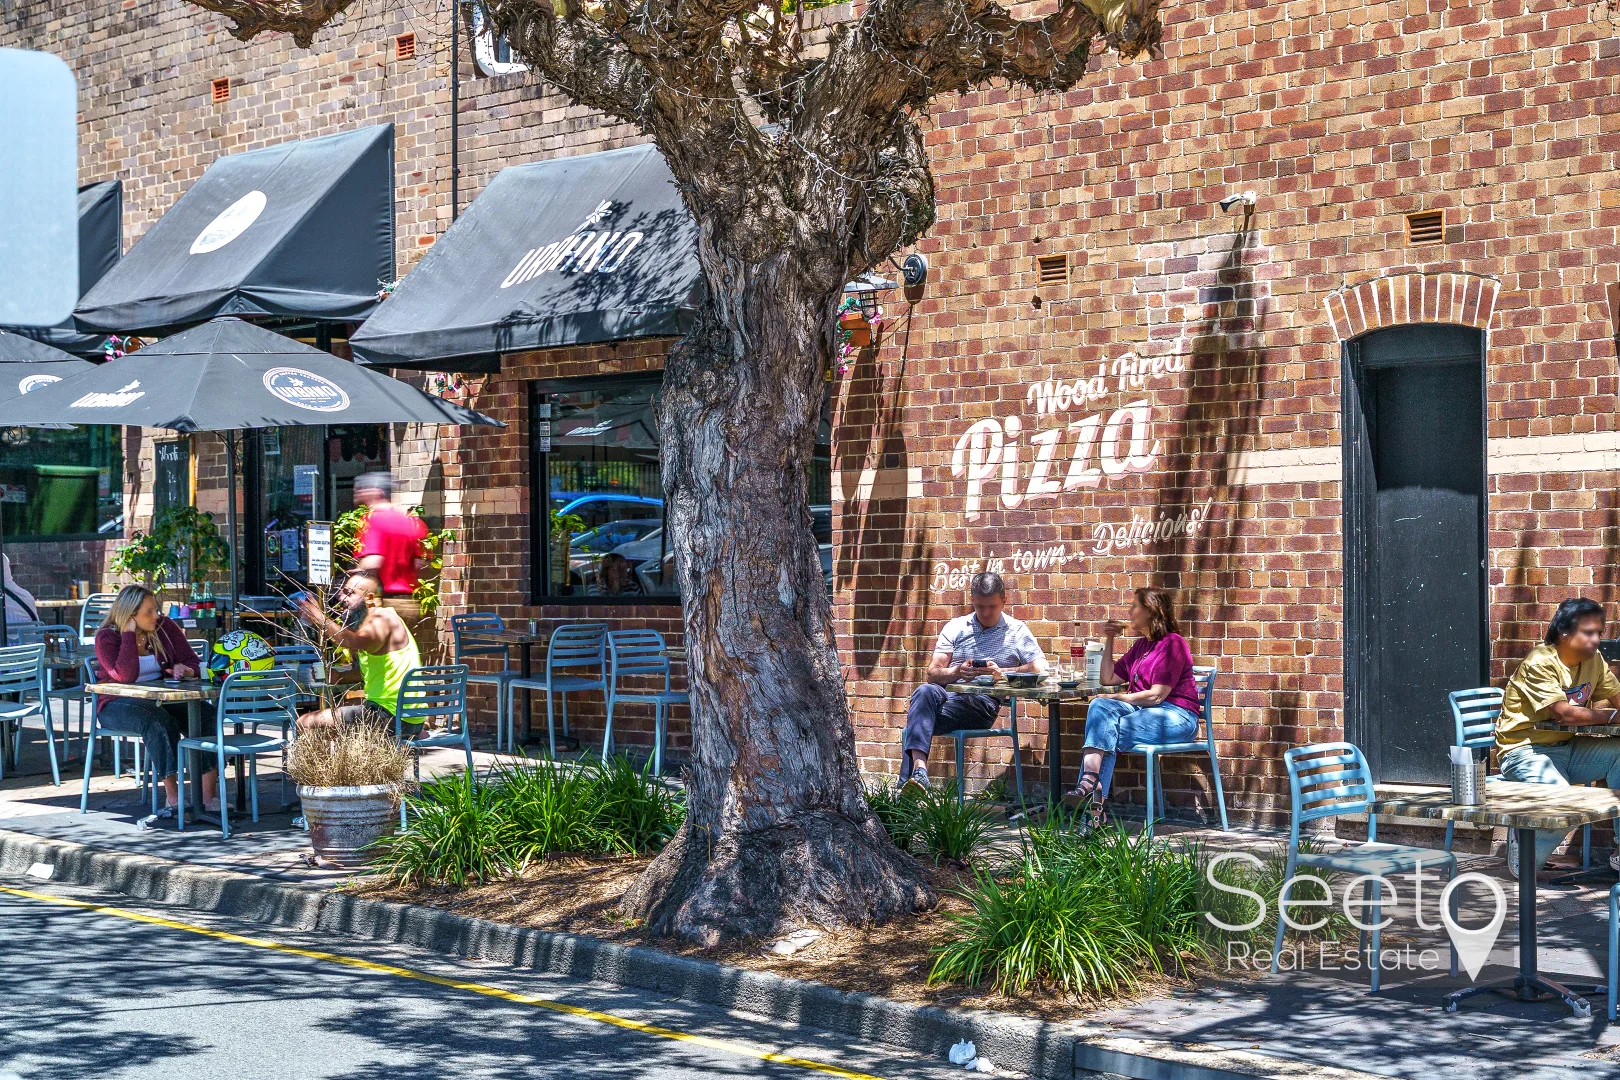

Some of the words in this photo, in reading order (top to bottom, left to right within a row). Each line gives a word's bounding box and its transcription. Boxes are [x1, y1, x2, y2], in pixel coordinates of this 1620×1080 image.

[500, 231, 644, 289] URBANO
[275, 385, 338, 398] URBANO
[1027, 354, 1109, 414] Wood
[1111, 337, 1184, 392] Fired
[952, 398, 1162, 523] Pizza
[930, 562, 981, 594] Best
[985, 551, 1006, 574] in
[1092, 496, 1213, 555] Delicious!
